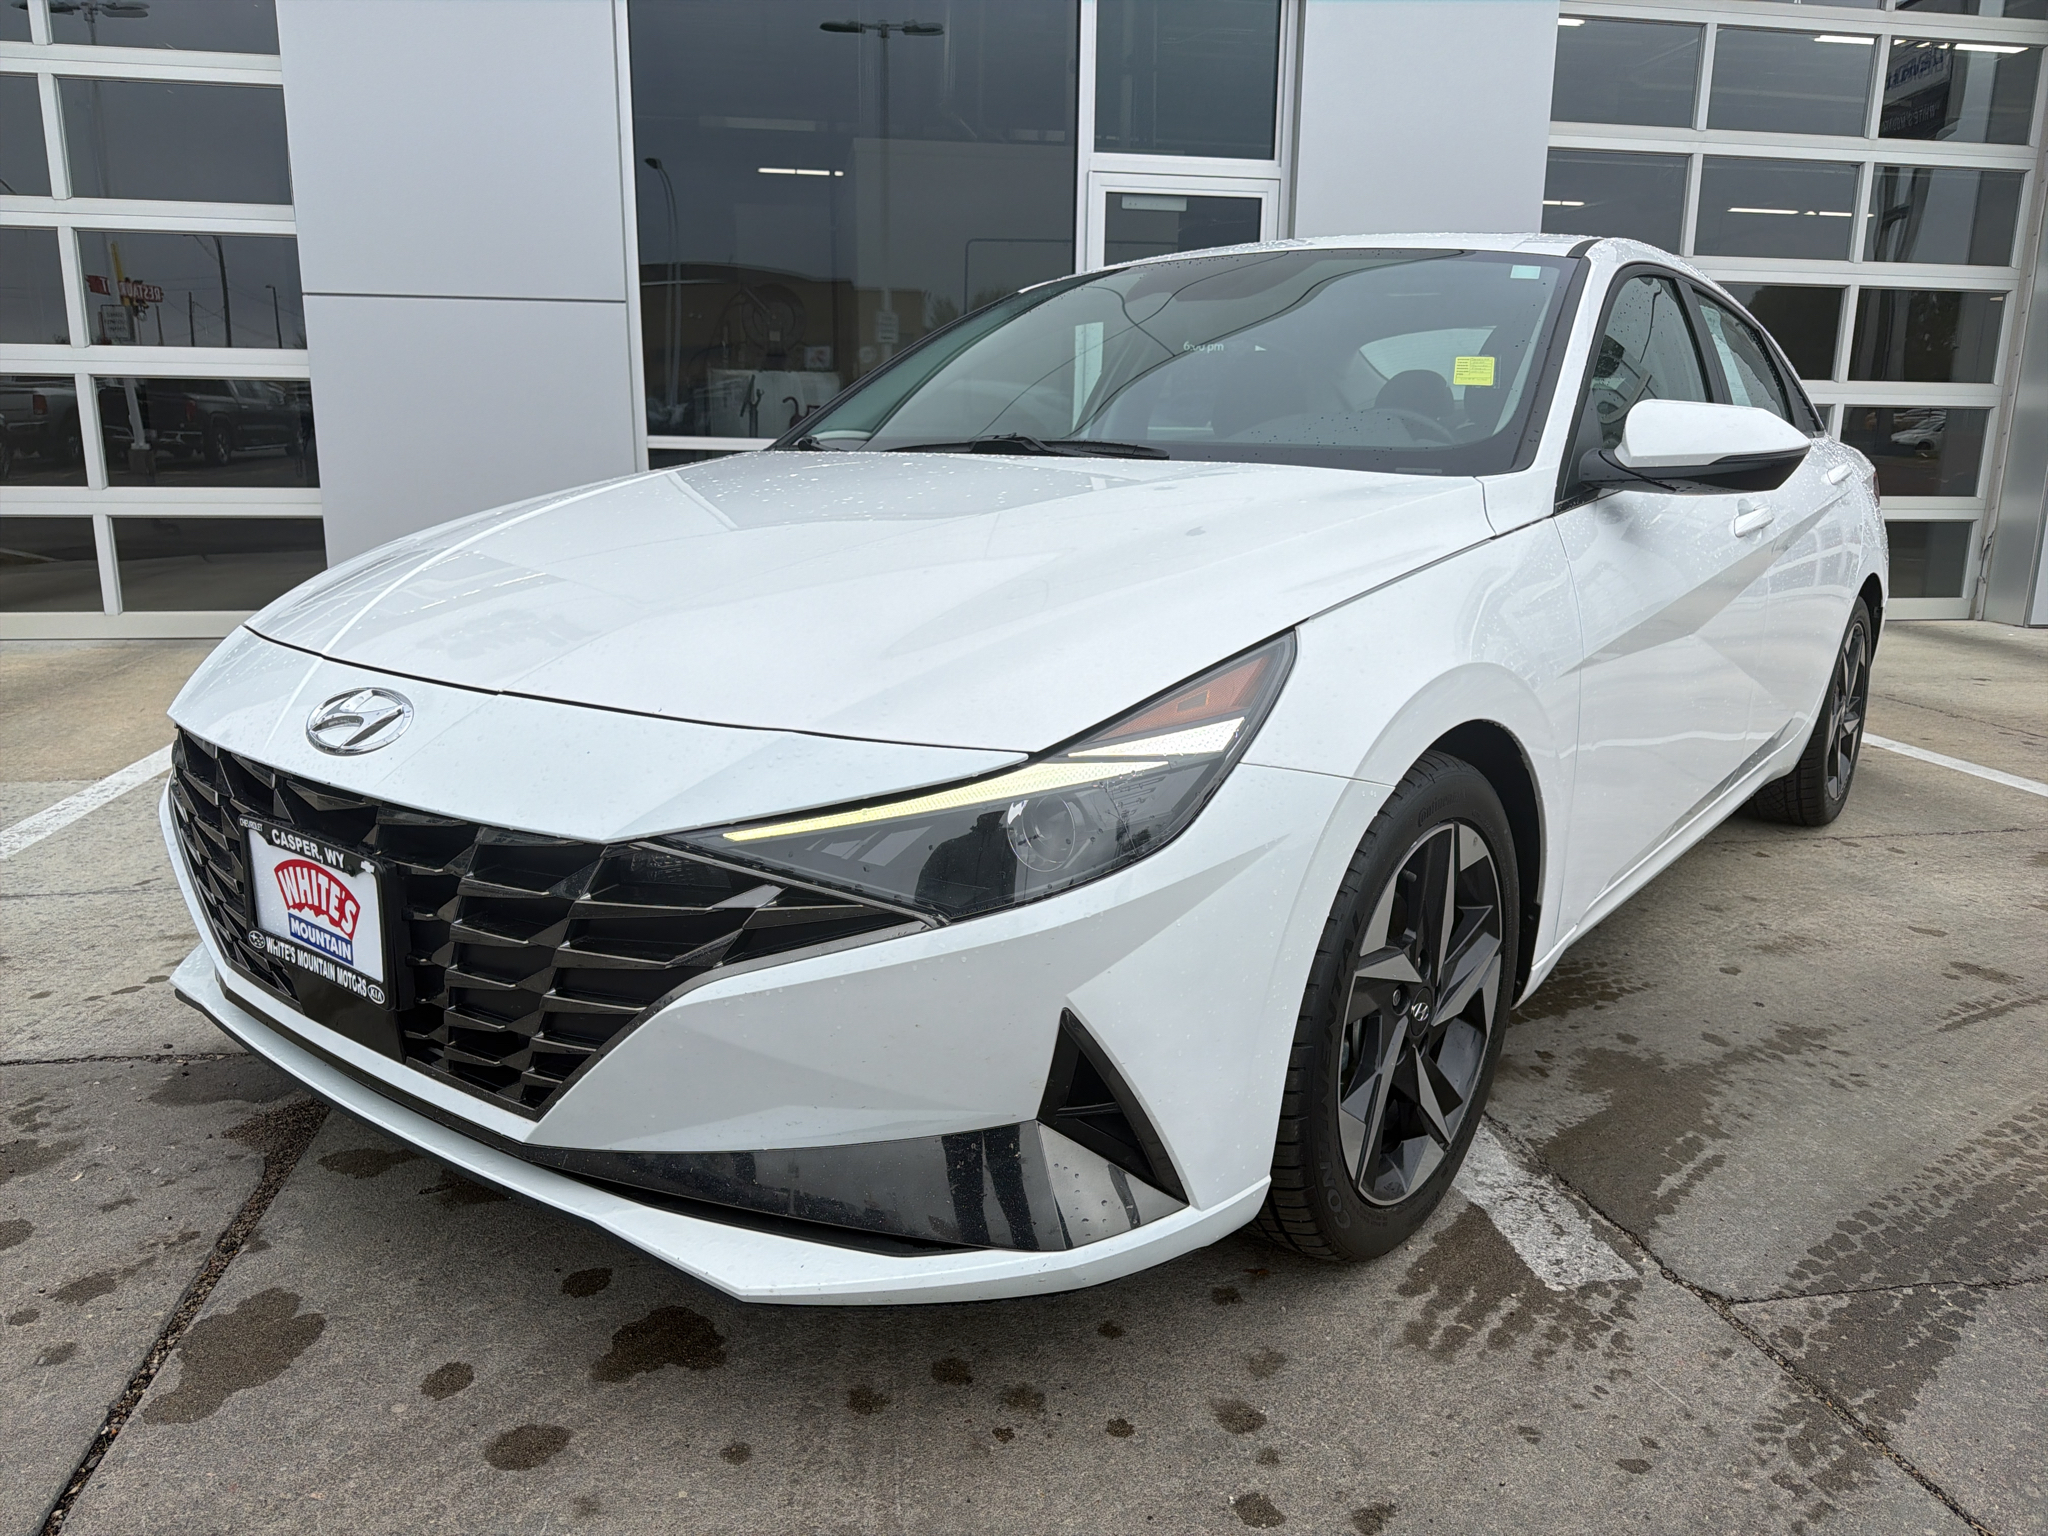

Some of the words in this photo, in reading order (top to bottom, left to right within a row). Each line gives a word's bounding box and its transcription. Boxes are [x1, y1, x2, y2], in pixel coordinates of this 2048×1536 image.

[1207, 343, 1224, 353] pm
[272, 829, 323, 864] CASPER,
[324, 847, 344, 868] WY
[278, 866, 357, 934] WHITE'S
[290, 917, 352, 961] MOUNTAIN
[265, 936, 296, 964] WHITE'S
[297, 949, 336, 982] MOUNTAIN
[336, 966, 367, 997] MOTORS
